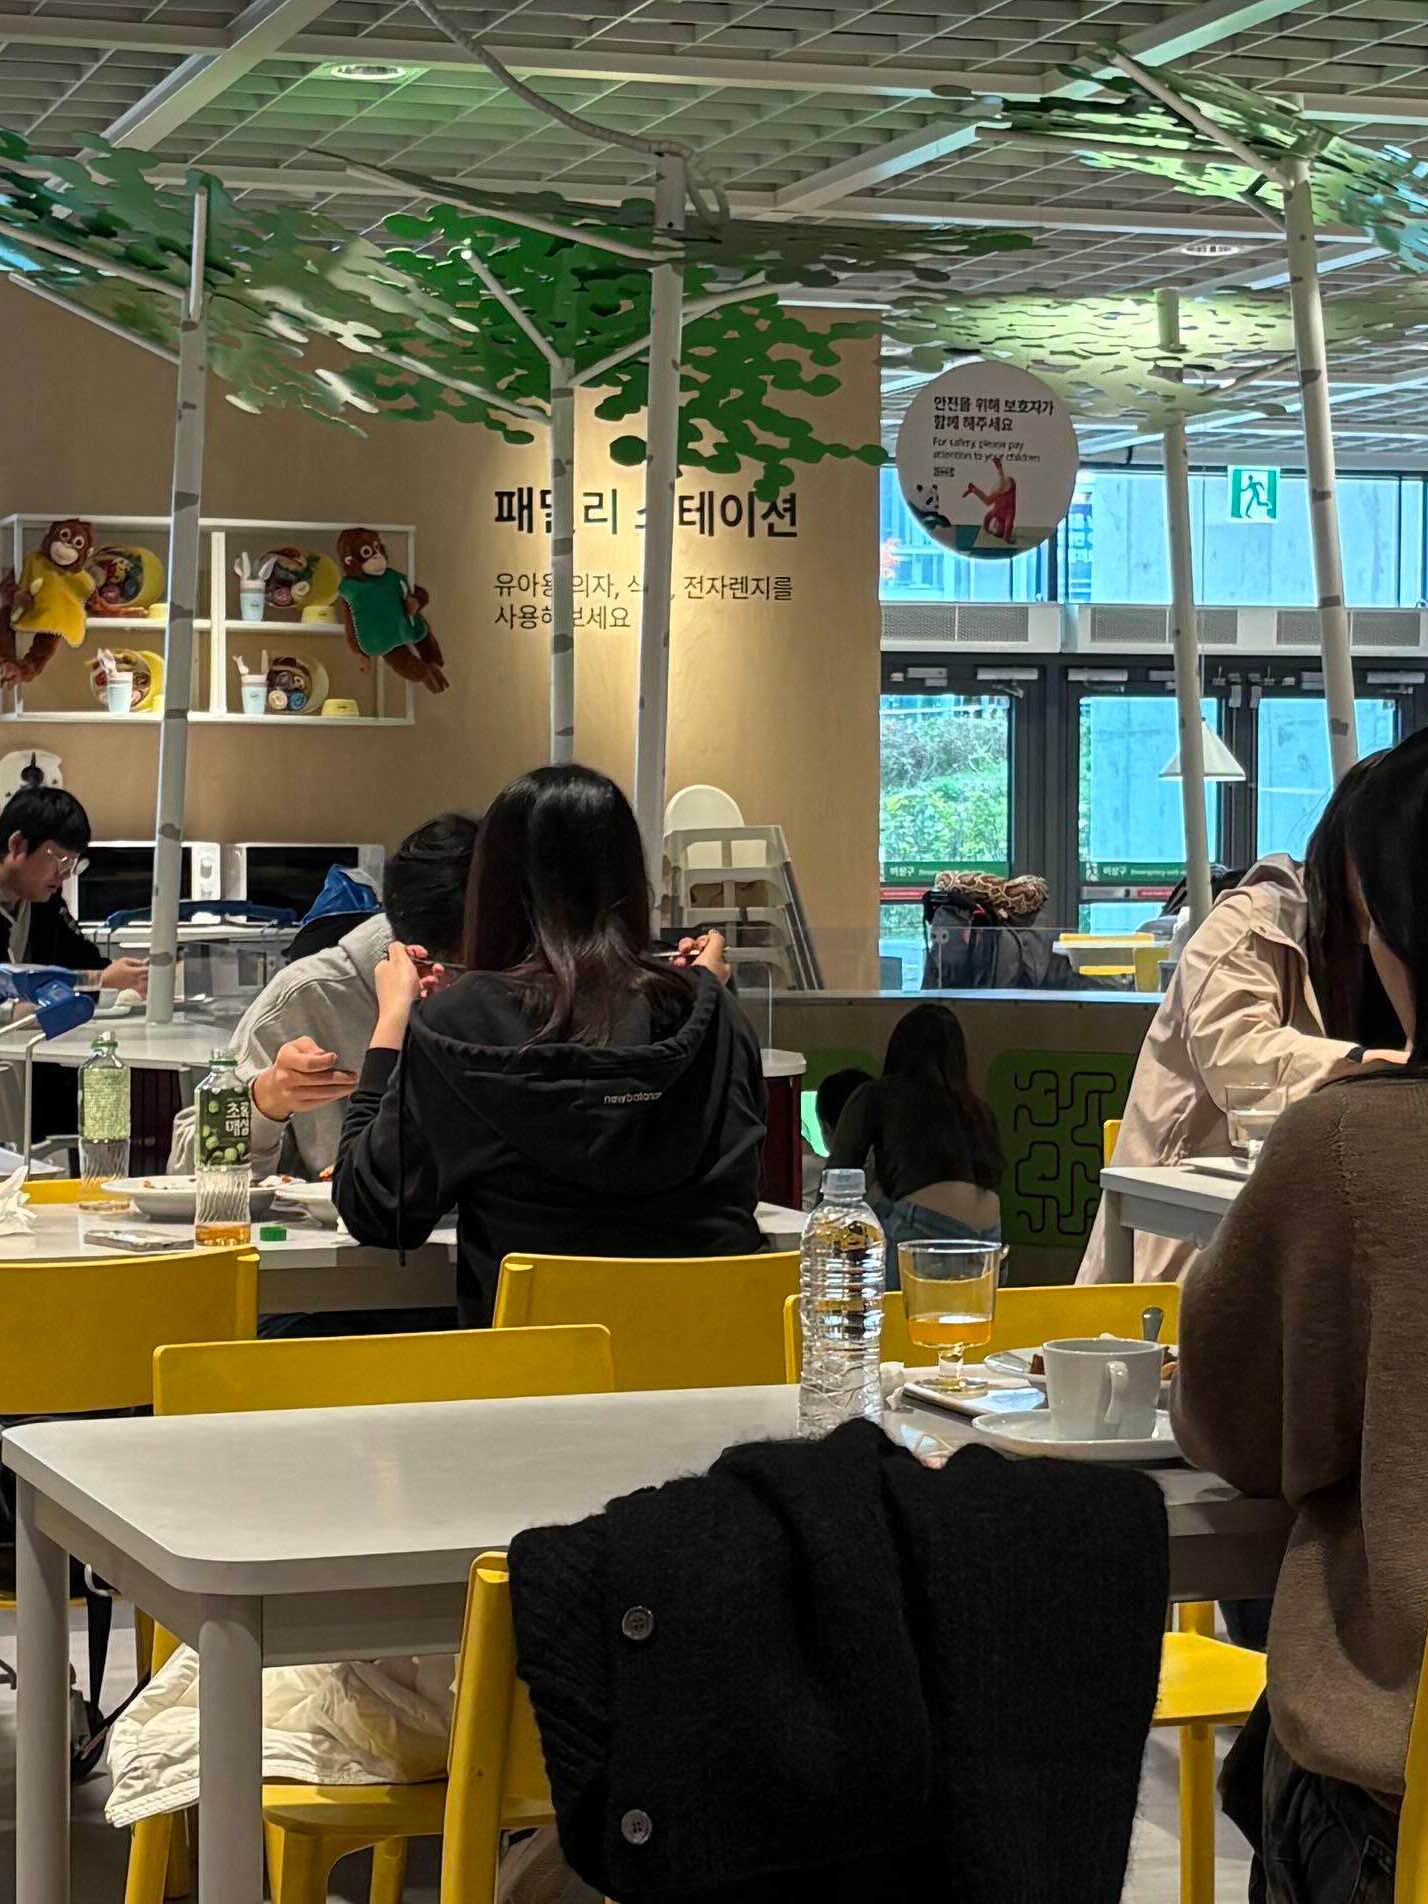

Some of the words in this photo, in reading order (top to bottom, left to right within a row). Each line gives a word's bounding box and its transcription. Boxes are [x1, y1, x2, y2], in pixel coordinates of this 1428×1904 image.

[934, 396, 970, 412] 안전을
[976, 398, 1000, 412] 위해
[1004, 399, 1054, 416] 보호자가
[963, 416, 1013, 432] 해주세요
[684, 575, 793, 600] 전자렌지를
